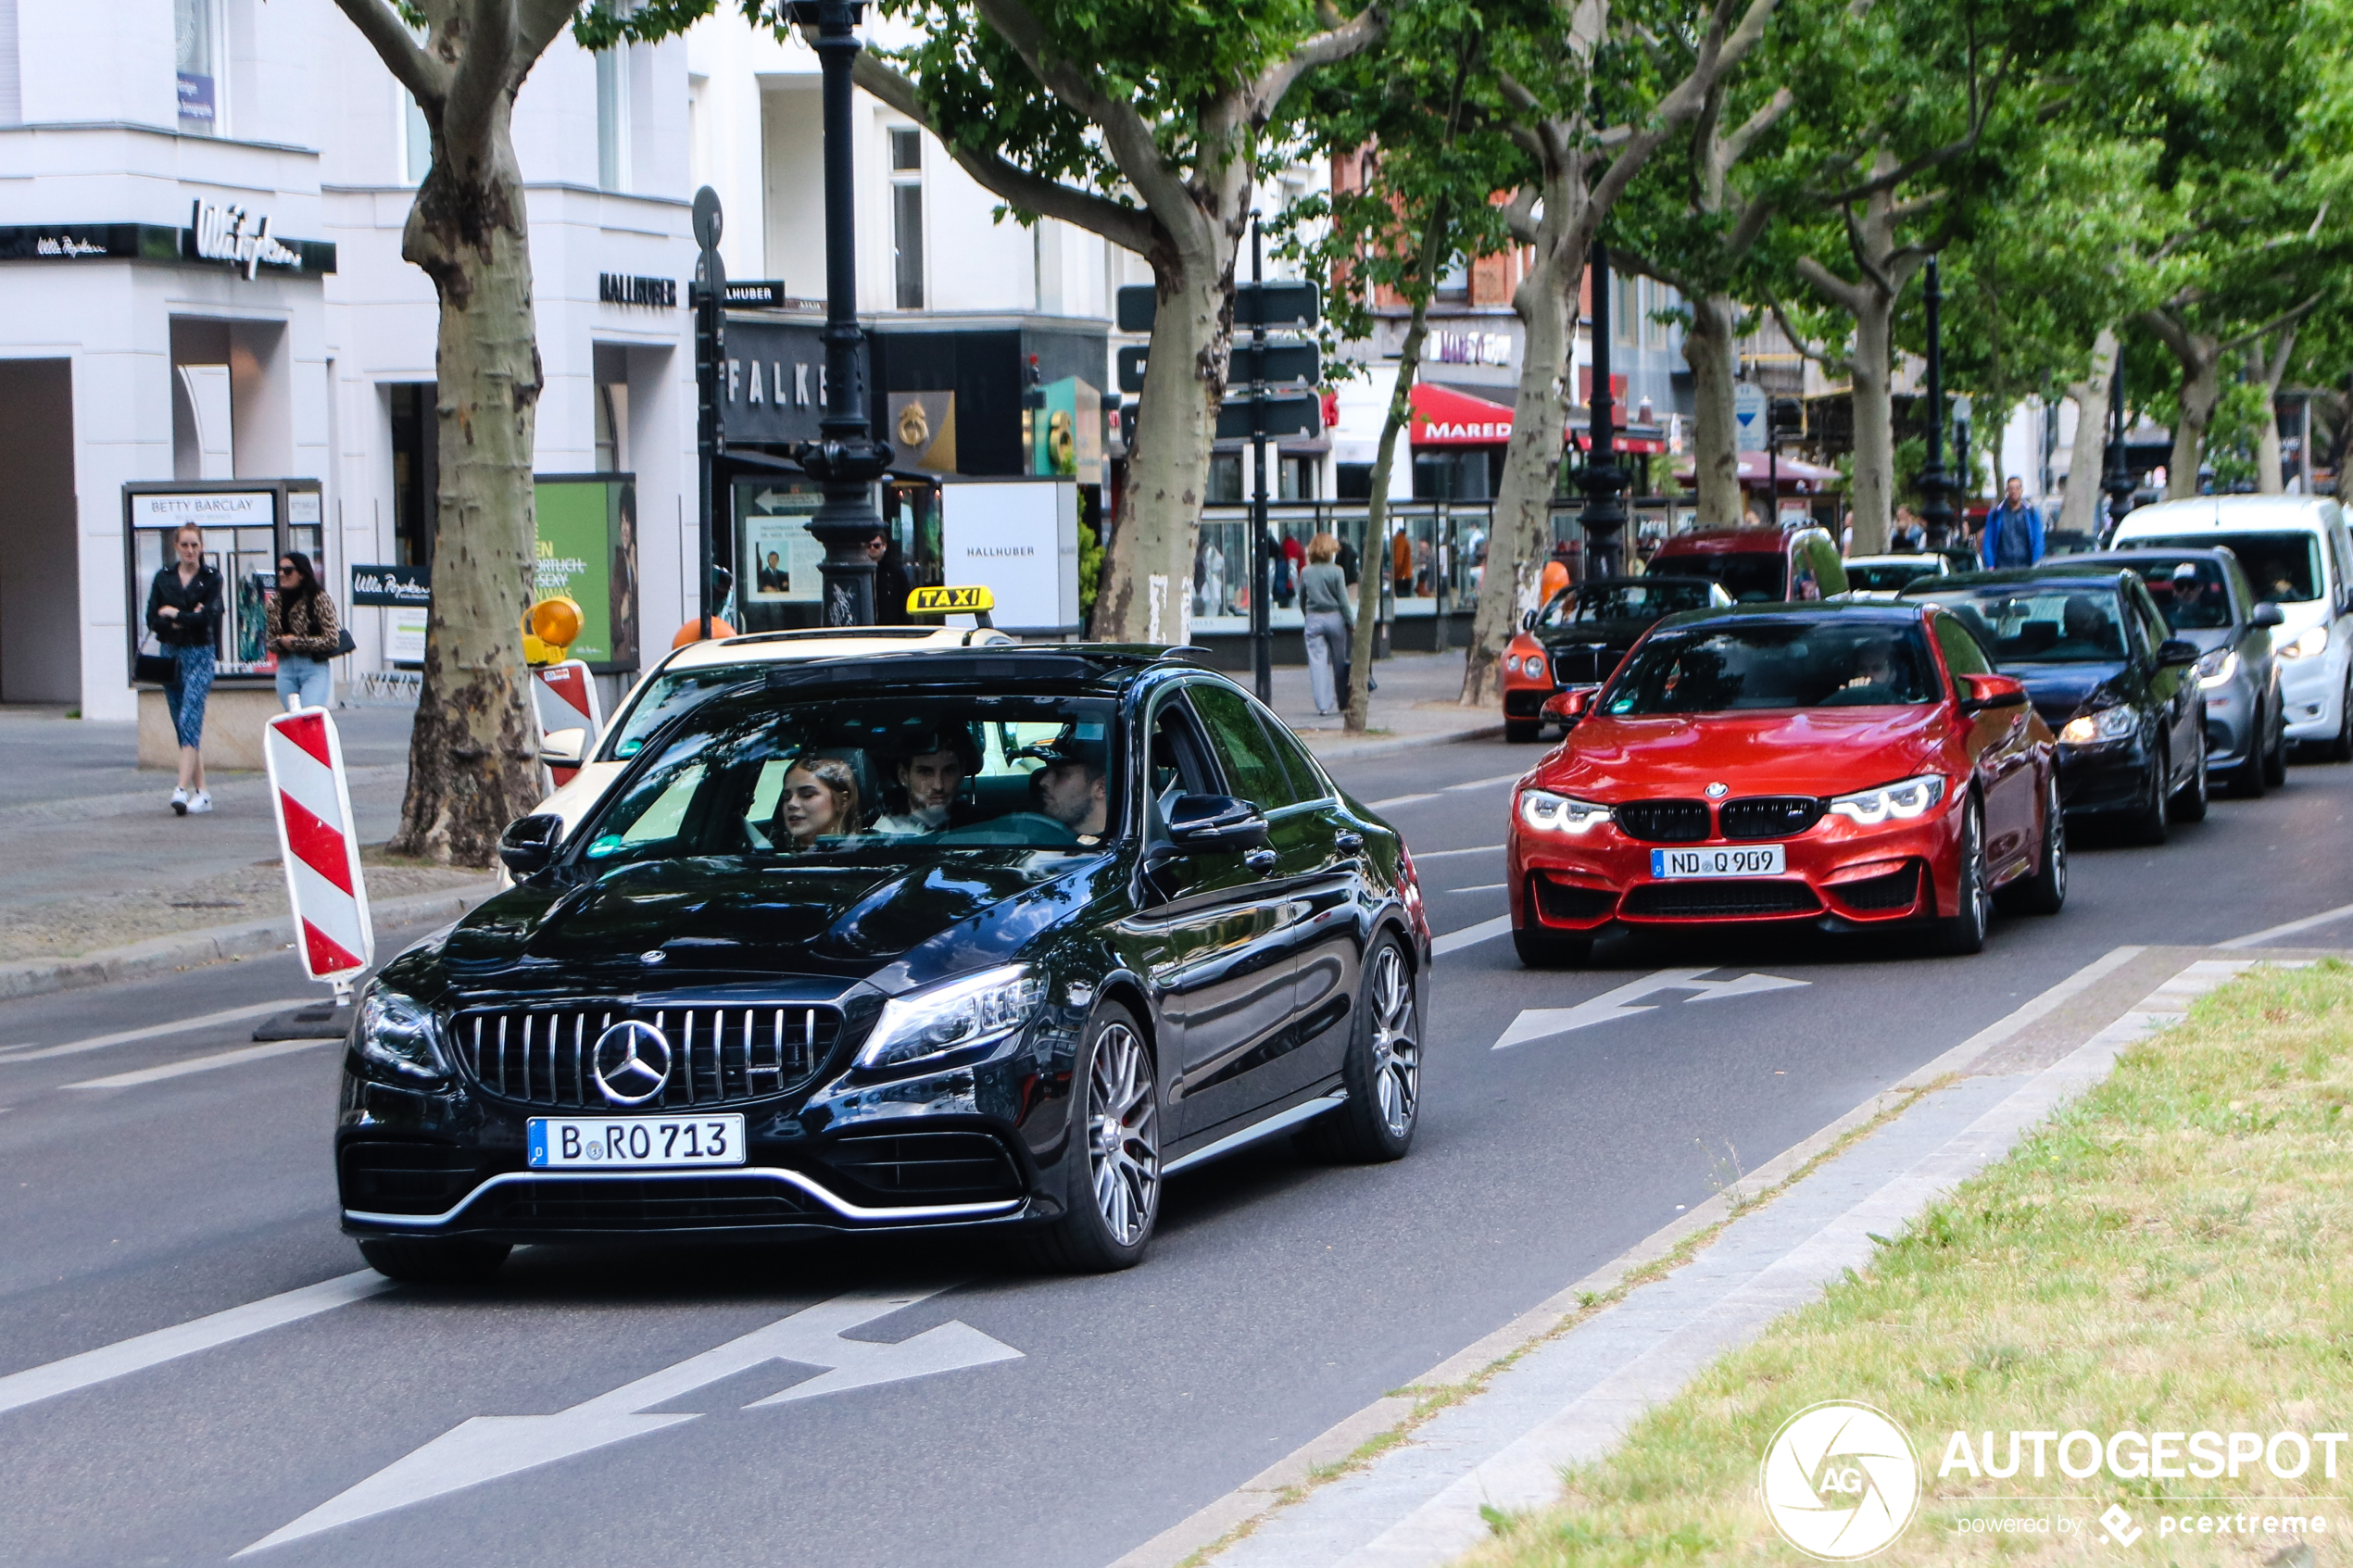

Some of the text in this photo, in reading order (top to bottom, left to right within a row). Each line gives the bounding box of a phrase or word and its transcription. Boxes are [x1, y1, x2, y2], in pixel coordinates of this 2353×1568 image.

[599, 272, 676, 307] HALLHUBER
[151, 498, 254, 513] BETTY BARCLAY
[967, 546, 1034, 557] HALLHUBER
[355, 572, 431, 599] Ulla Popken
[922, 589, 977, 607] TAXI
[1672, 853, 1699, 873] ND
[1715, 853, 1728, 872] Q
[1733, 850, 1773, 872] 909
[535, 1122, 727, 1160] D B RO 713
